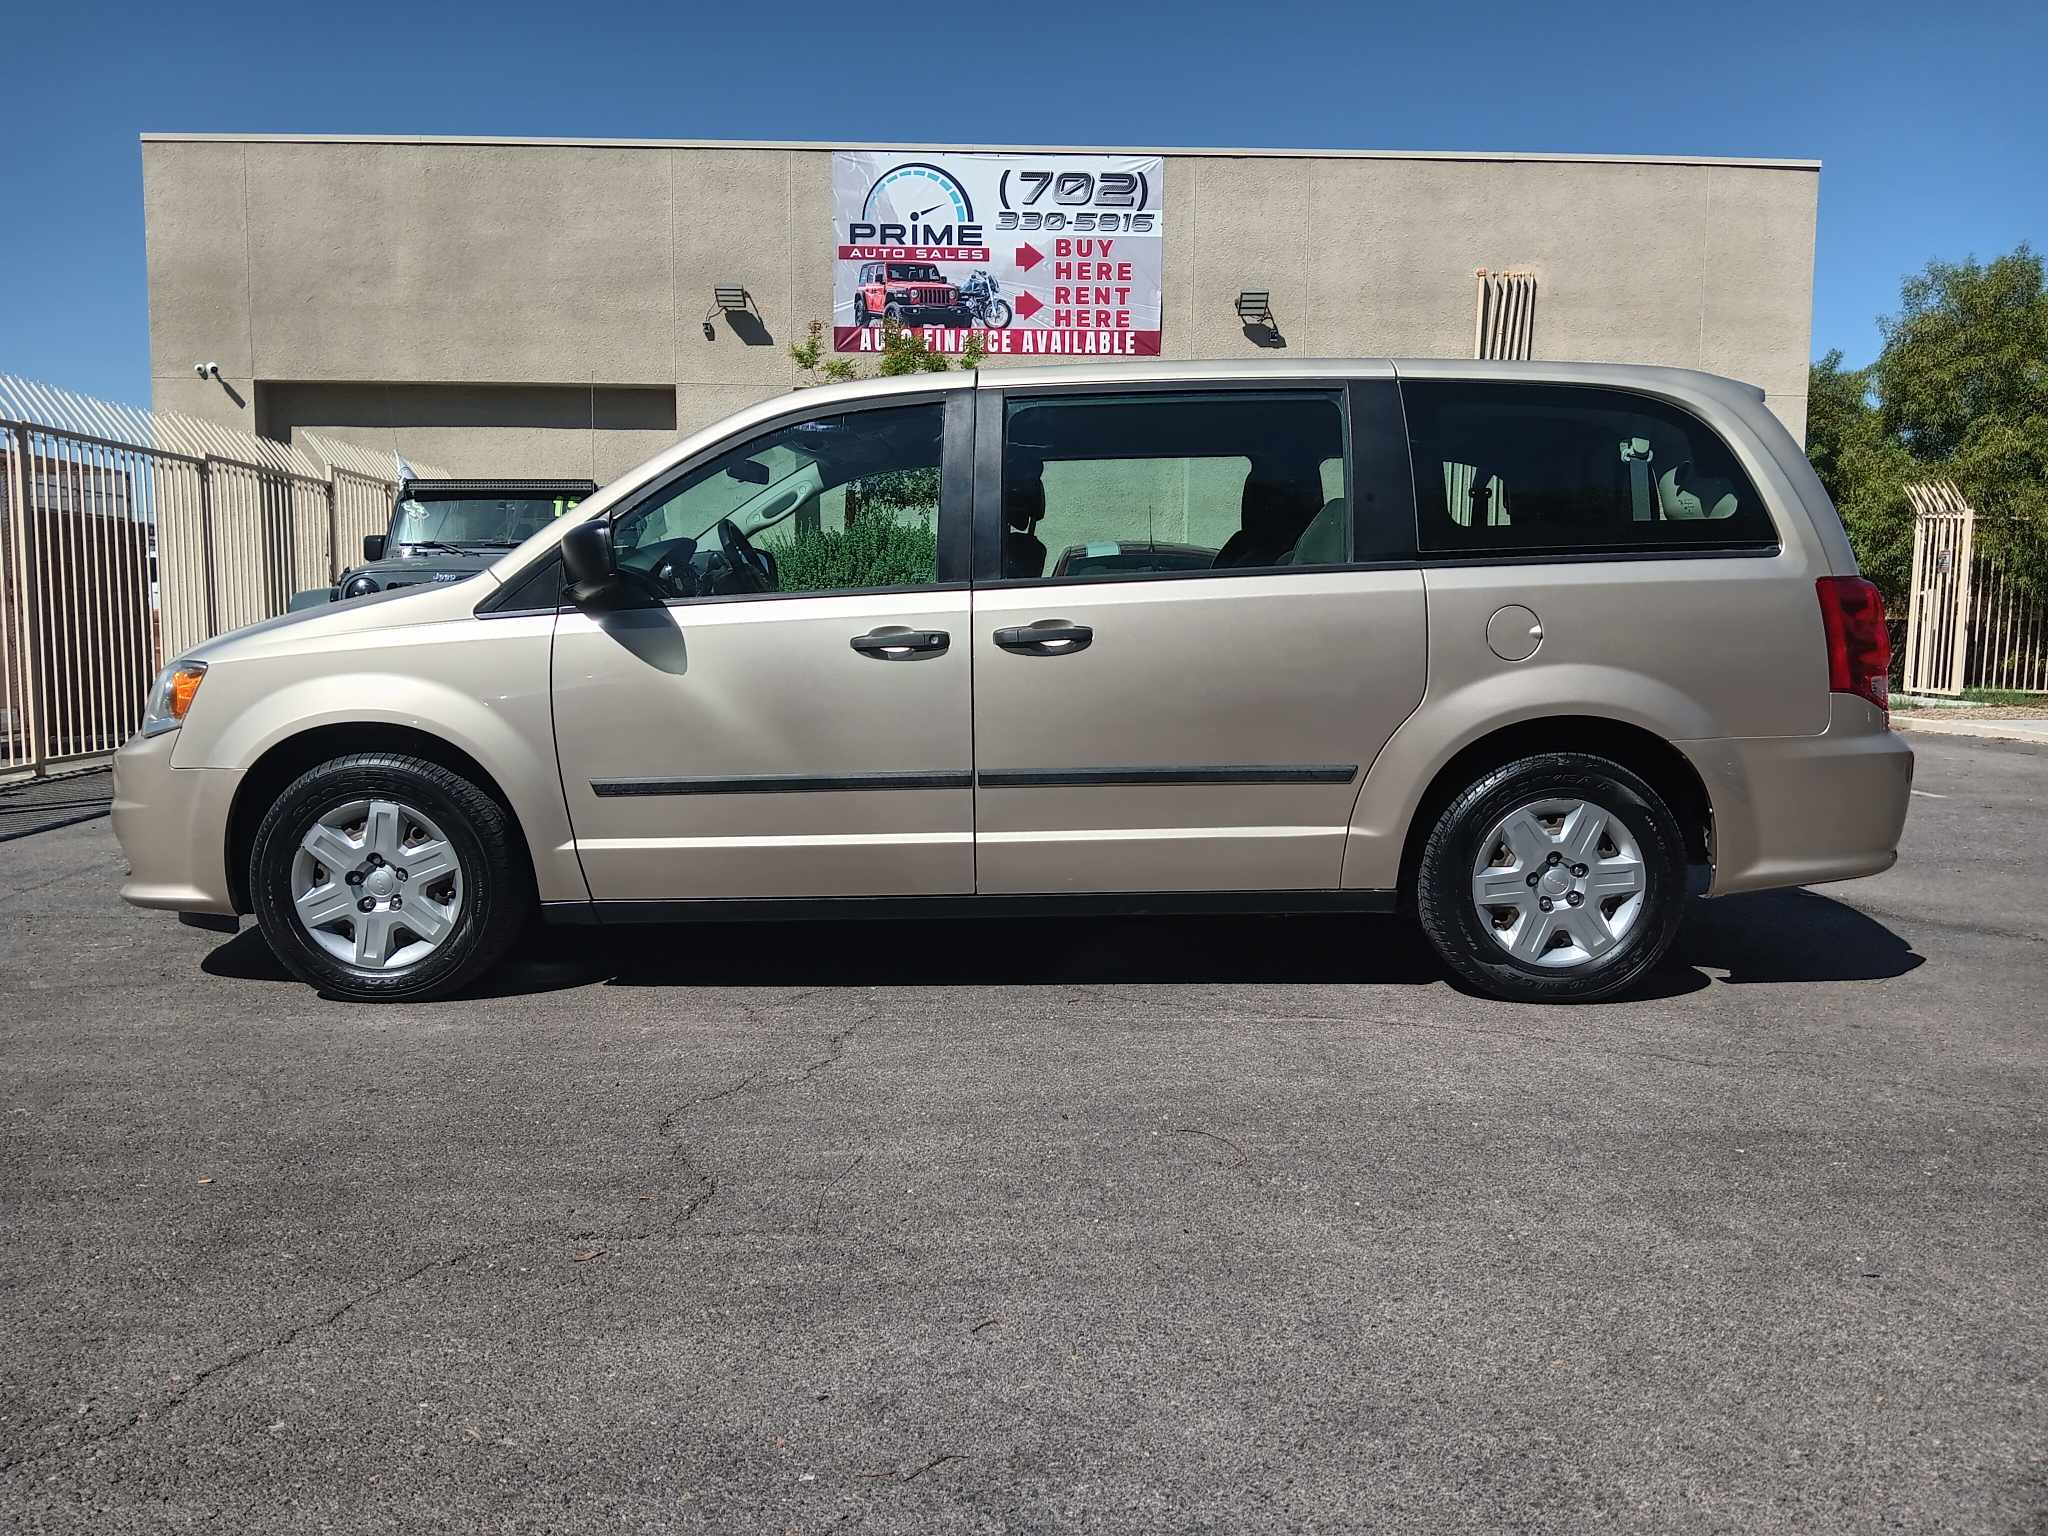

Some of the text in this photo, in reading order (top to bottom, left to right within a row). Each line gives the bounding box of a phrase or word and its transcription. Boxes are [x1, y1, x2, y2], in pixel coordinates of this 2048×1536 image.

[999, 169, 1149, 211] (702)
[995, 211, 1155, 233] 330-5816
[849, 248, 984, 260] AUTO SALES
[1055, 238, 1113, 258] BUY
[1054, 262, 1132, 281] HERE
[1055, 286, 1130, 305] RENT
[1054, 309, 1130, 328] HERE
[860, 328, 912, 352] AU
[1022, 330, 1135, 354] AVAILABLE
